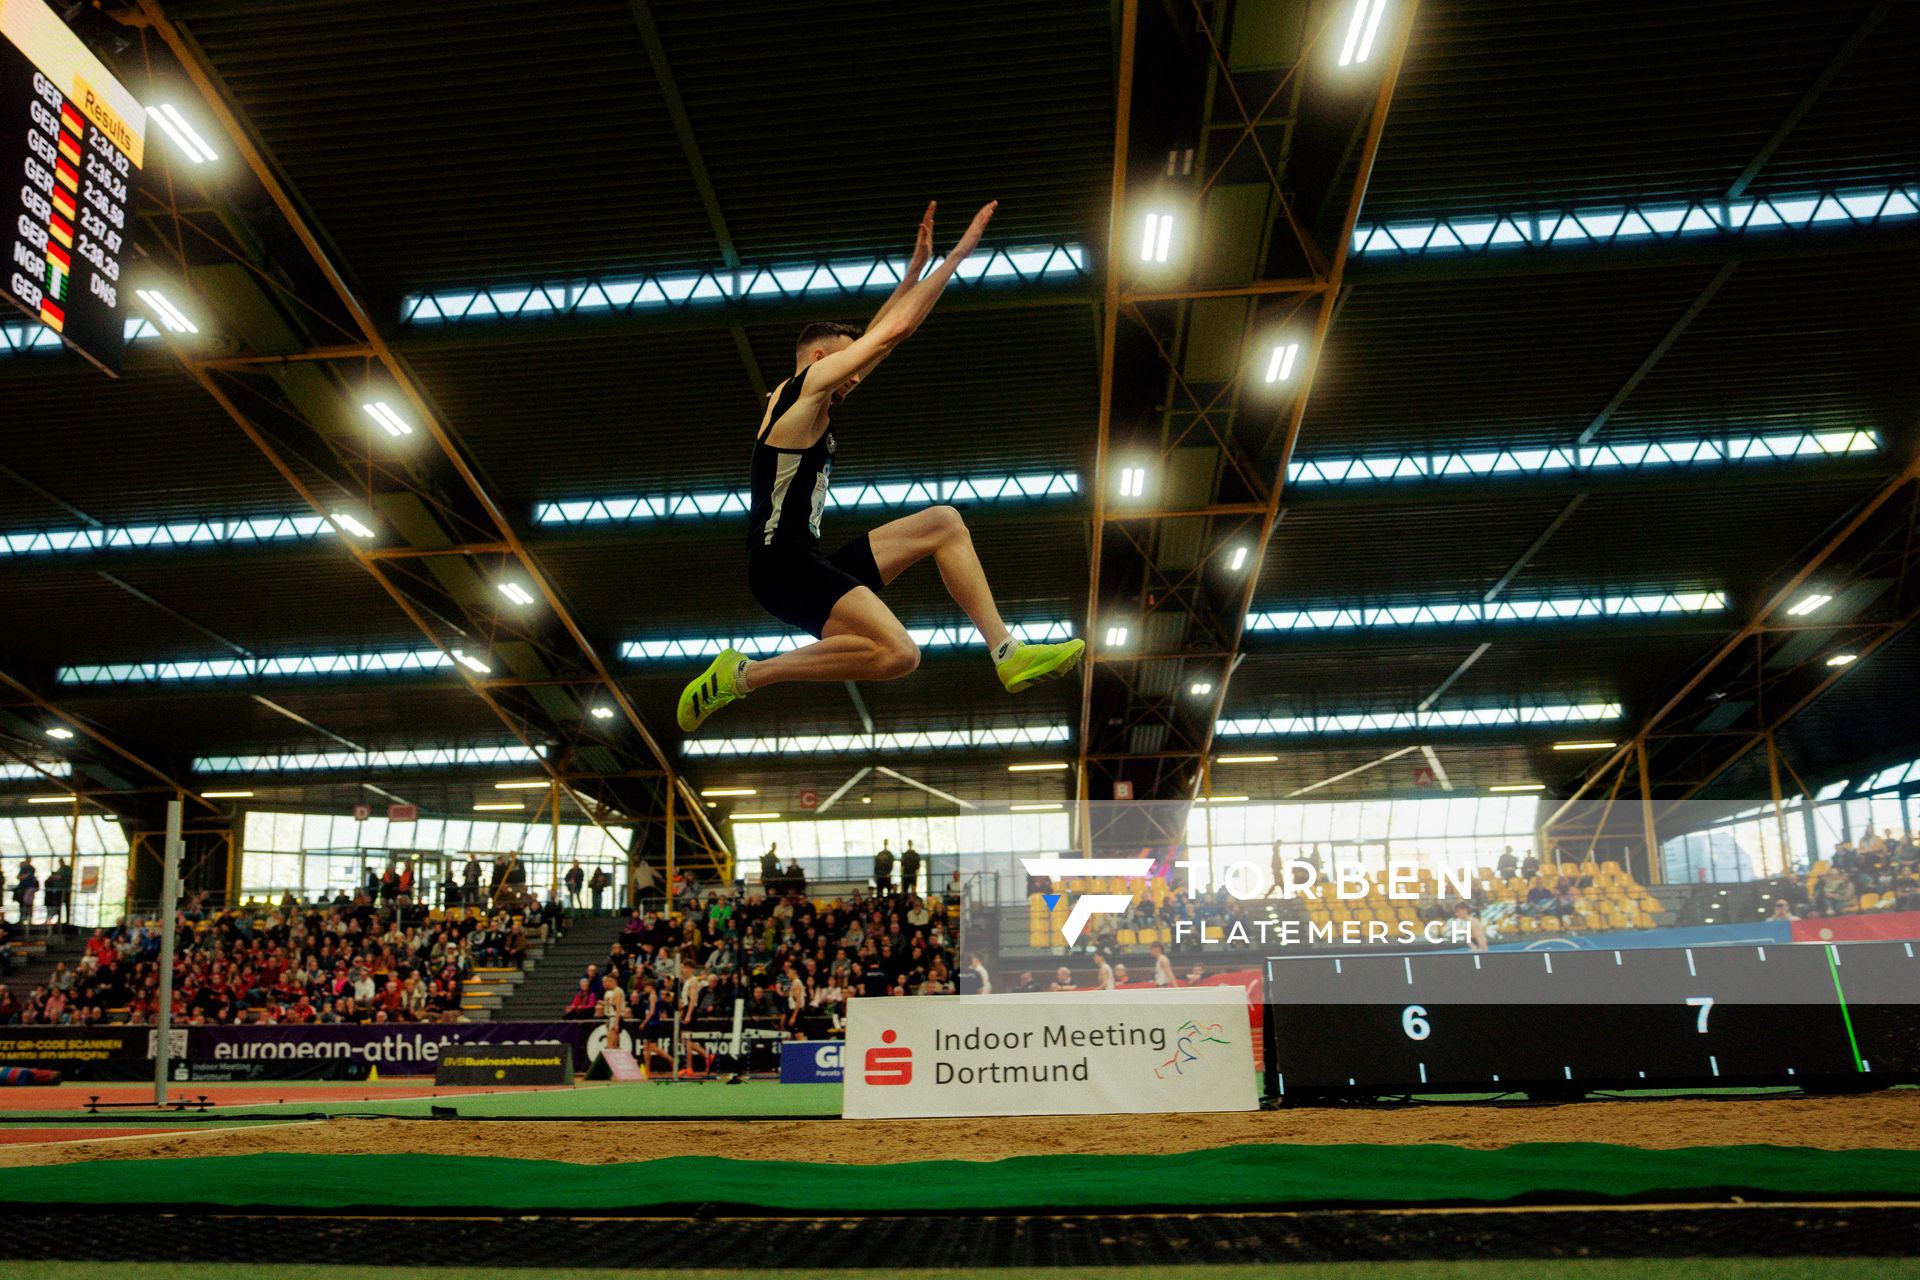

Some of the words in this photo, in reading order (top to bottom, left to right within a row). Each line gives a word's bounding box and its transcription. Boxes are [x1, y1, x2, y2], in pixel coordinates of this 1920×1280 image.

[33, 72, 63, 113] GER
[89, 126, 129, 178] 2:34.82
[85, 90, 131, 151] Results
[27, 128, 57, 169] GER
[30, 100, 60, 141] GER
[86, 153, 127, 204] 2:35.24
[24, 156, 54, 197] GER
[21, 185, 52, 225] GER
[13, 241, 46, 282] NGR
[17, 214, 49, 253] GER
[90, 272, 117, 308] DNS
[11, 272, 43, 311] GER
[1402, 1005, 1430, 1040] 6
[1686, 997, 1714, 1033] 7
[17, 1040, 66, 1050] QR-CODE
[68, 1040, 122, 1050] SCANNEN
[635, 1037, 671, 1055] Hlf
[935, 1028, 1033, 1050] Indoor
[1044, 1023, 1167, 1050] Meeting
[935, 1057, 1089, 1084] Dortmund
